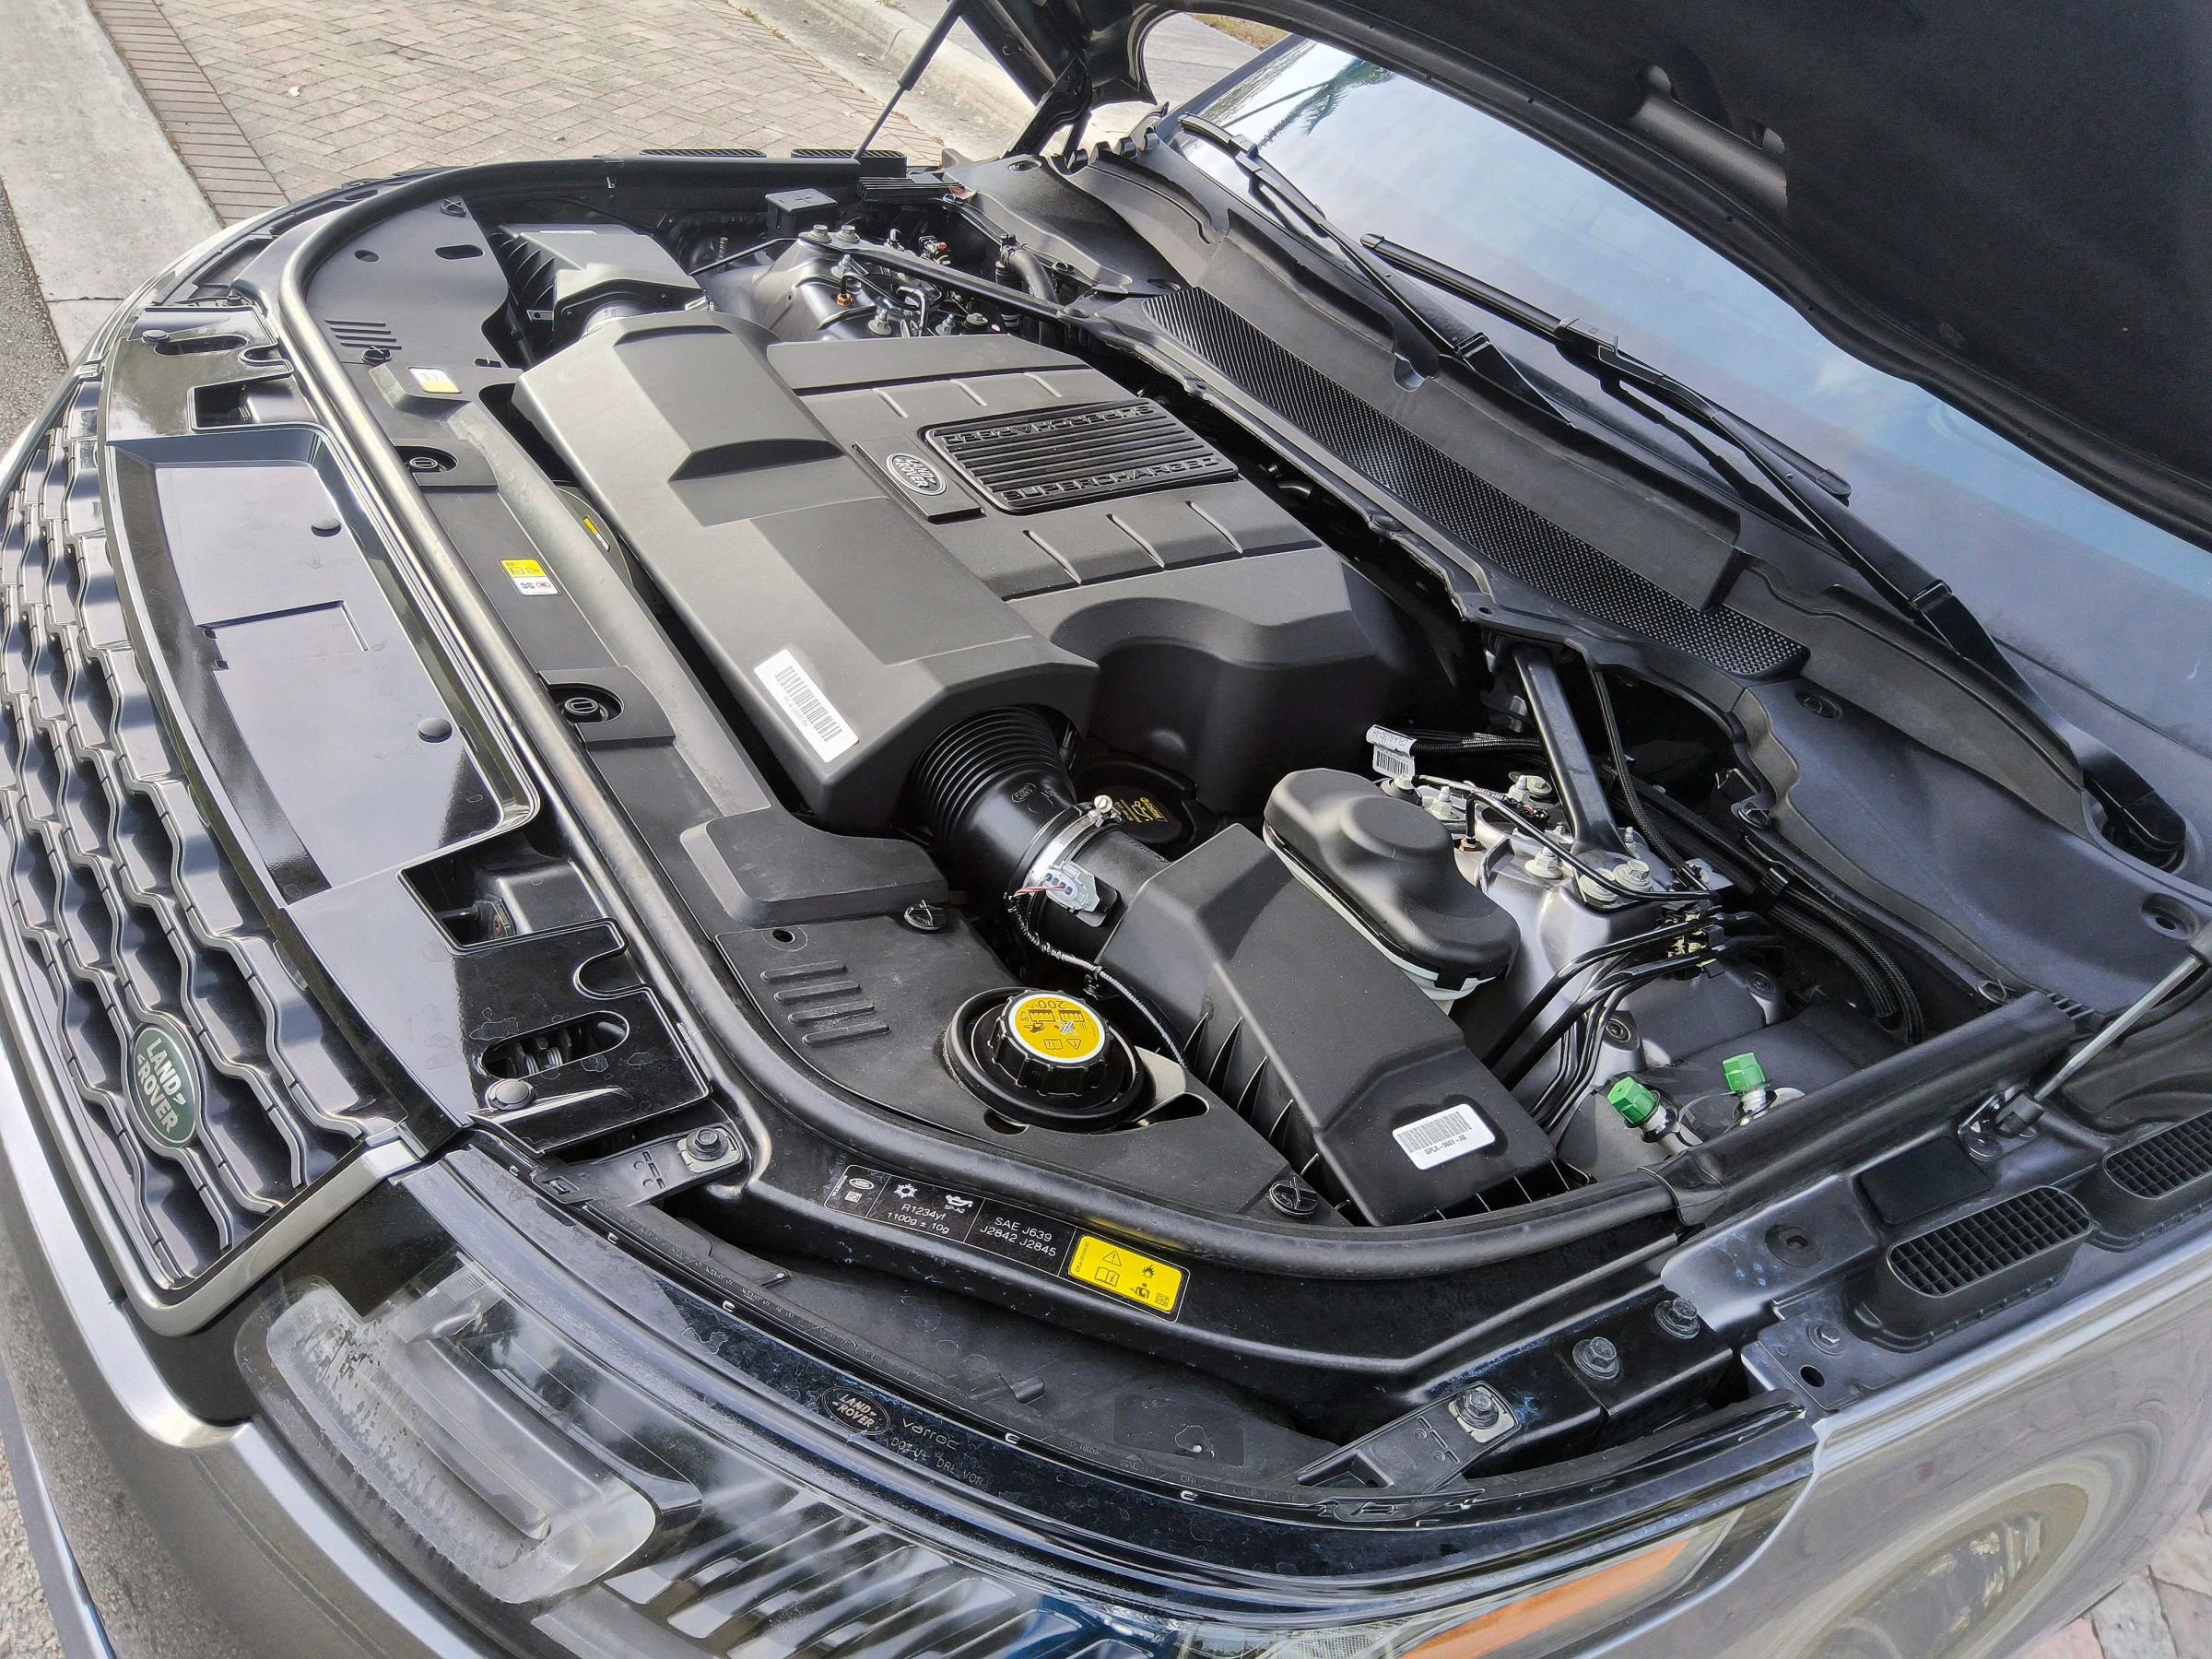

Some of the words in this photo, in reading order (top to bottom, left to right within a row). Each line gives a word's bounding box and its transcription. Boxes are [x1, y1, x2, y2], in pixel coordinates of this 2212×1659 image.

[895, 461, 930, 488] ROVER
[1002, 456, 1220, 500] SUPERCHARGED
[1039, 1000, 1065, 1009] 200
[147, 1037, 182, 1097] LAND
[137, 1059, 180, 1135] ROVER
[887, 1211, 918, 1227] 1100g
[932, 1222, 950, 1235] 10g
[900, 1203, 947, 1221] R1234yf
[980, 1225, 1018, 1243] J2842
[1018, 1238, 1057, 1257] J2845
[994, 1217, 1021, 1232] SAE
[1021, 1226, 1053, 1242] J639
[836, 1404, 876, 1429] ROVER
[839, 1394, 872, 1414] LAND
[901, 1417, 959, 1451] varroc
